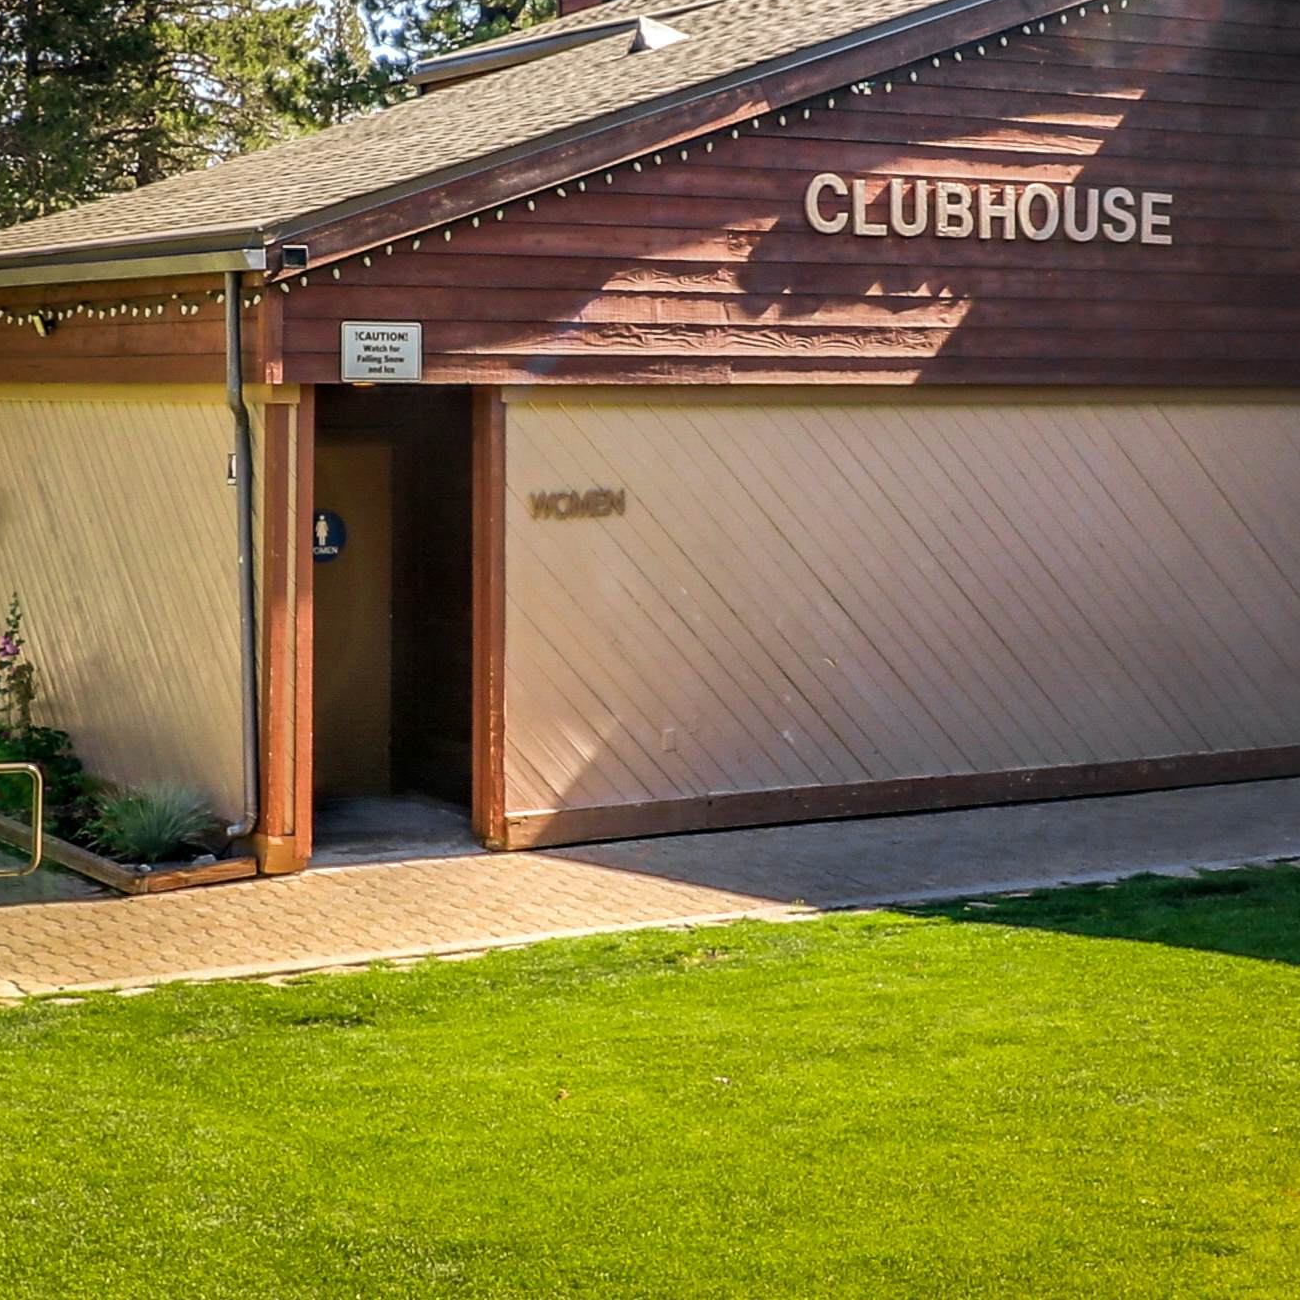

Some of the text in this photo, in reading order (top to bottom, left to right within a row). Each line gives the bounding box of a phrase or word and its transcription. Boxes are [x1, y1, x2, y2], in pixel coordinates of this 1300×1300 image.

[804, 172, 1173, 245] CLUBHOUSE
[363, 344, 400, 352] Watch for
[356, 354, 382, 364] Falling
[368, 365, 383, 373] and
[313, 546, 339, 555] OMEN
